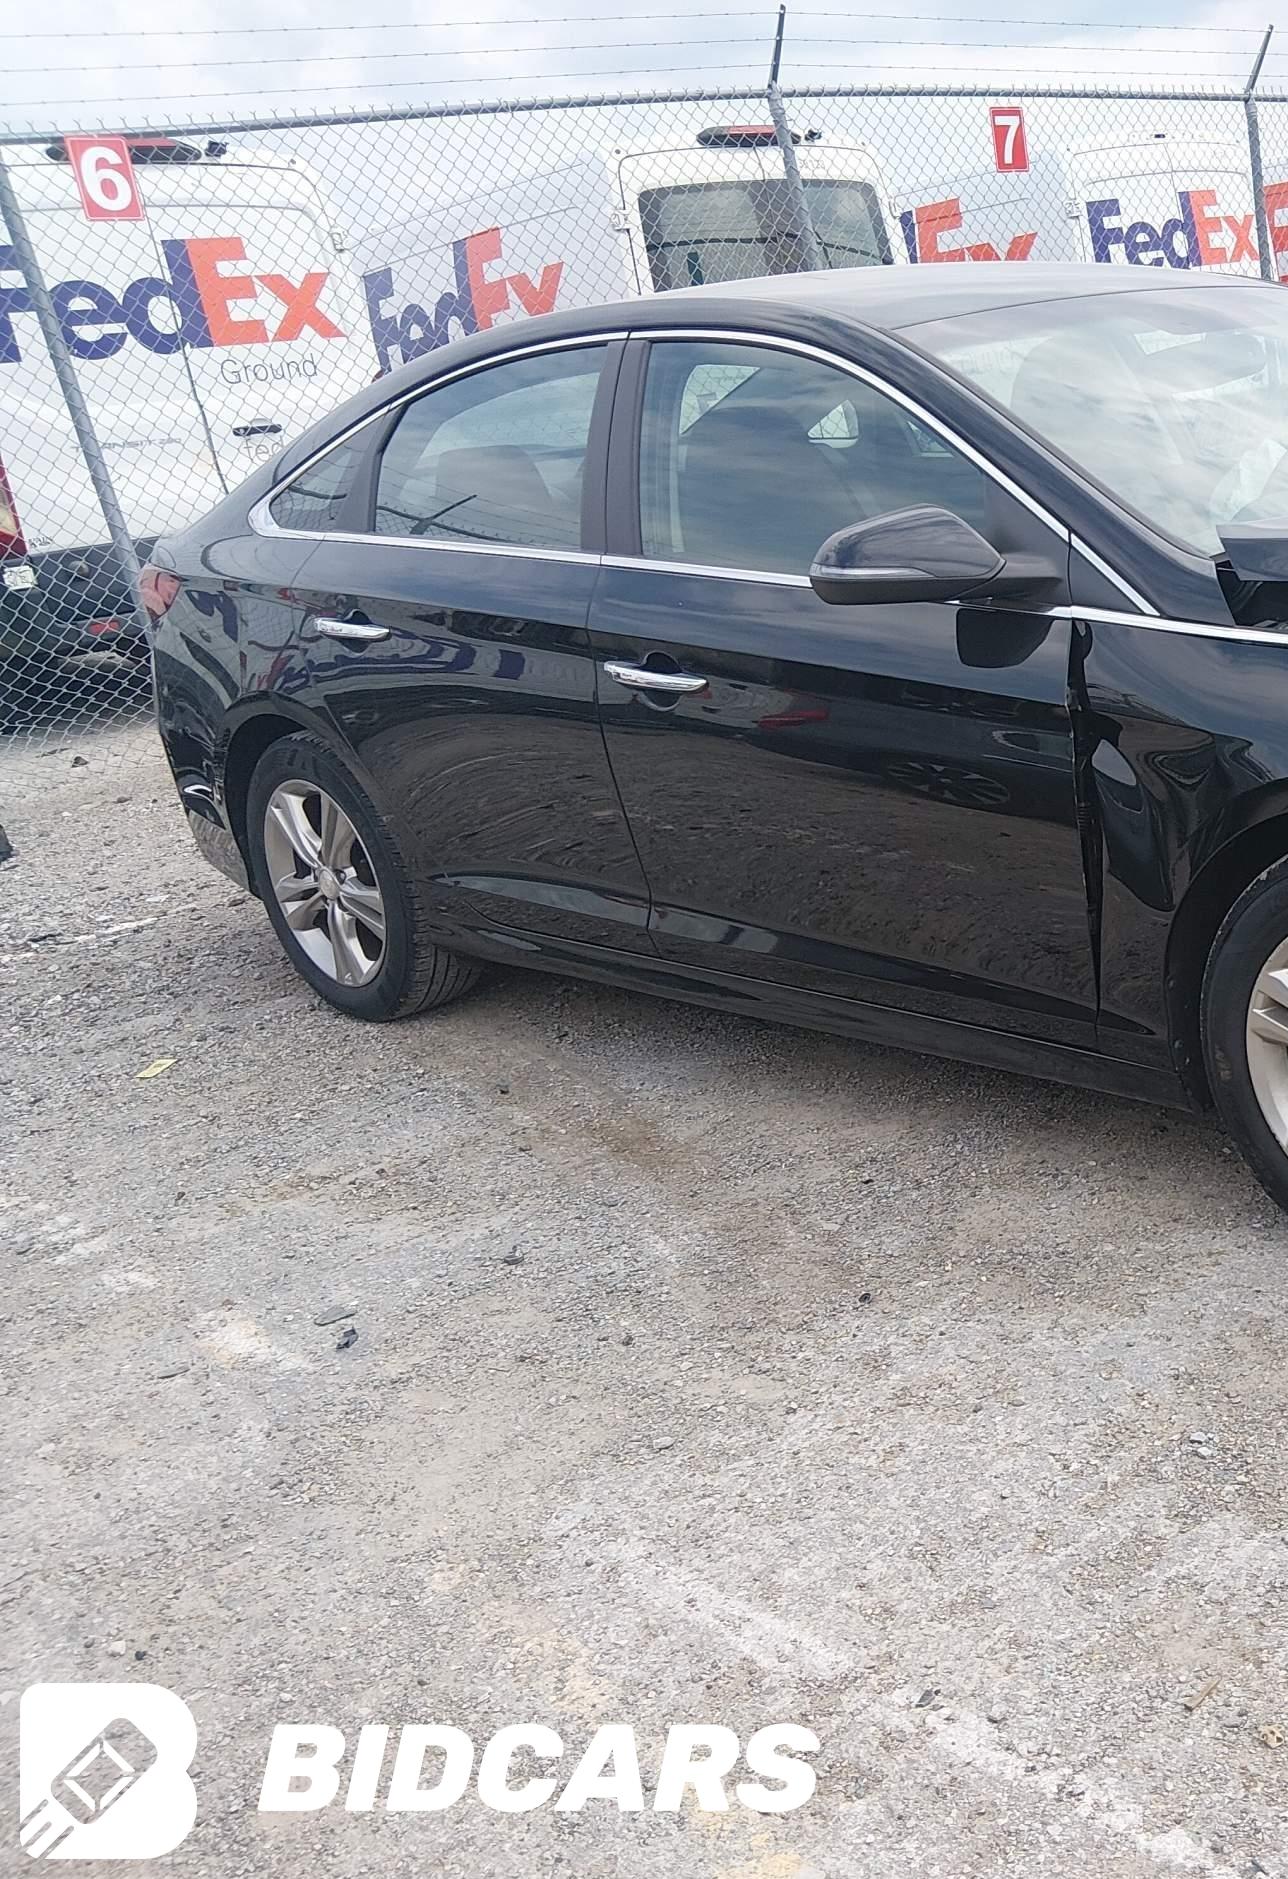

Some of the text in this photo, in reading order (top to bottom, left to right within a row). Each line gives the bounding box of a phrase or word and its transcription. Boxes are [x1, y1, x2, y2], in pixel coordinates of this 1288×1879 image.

[995, 116, 1020, 164] 7
[80, 146, 132, 211] 6
[1086, 189, 1261, 269] FedEx
[220, 353, 318, 385] Ground
